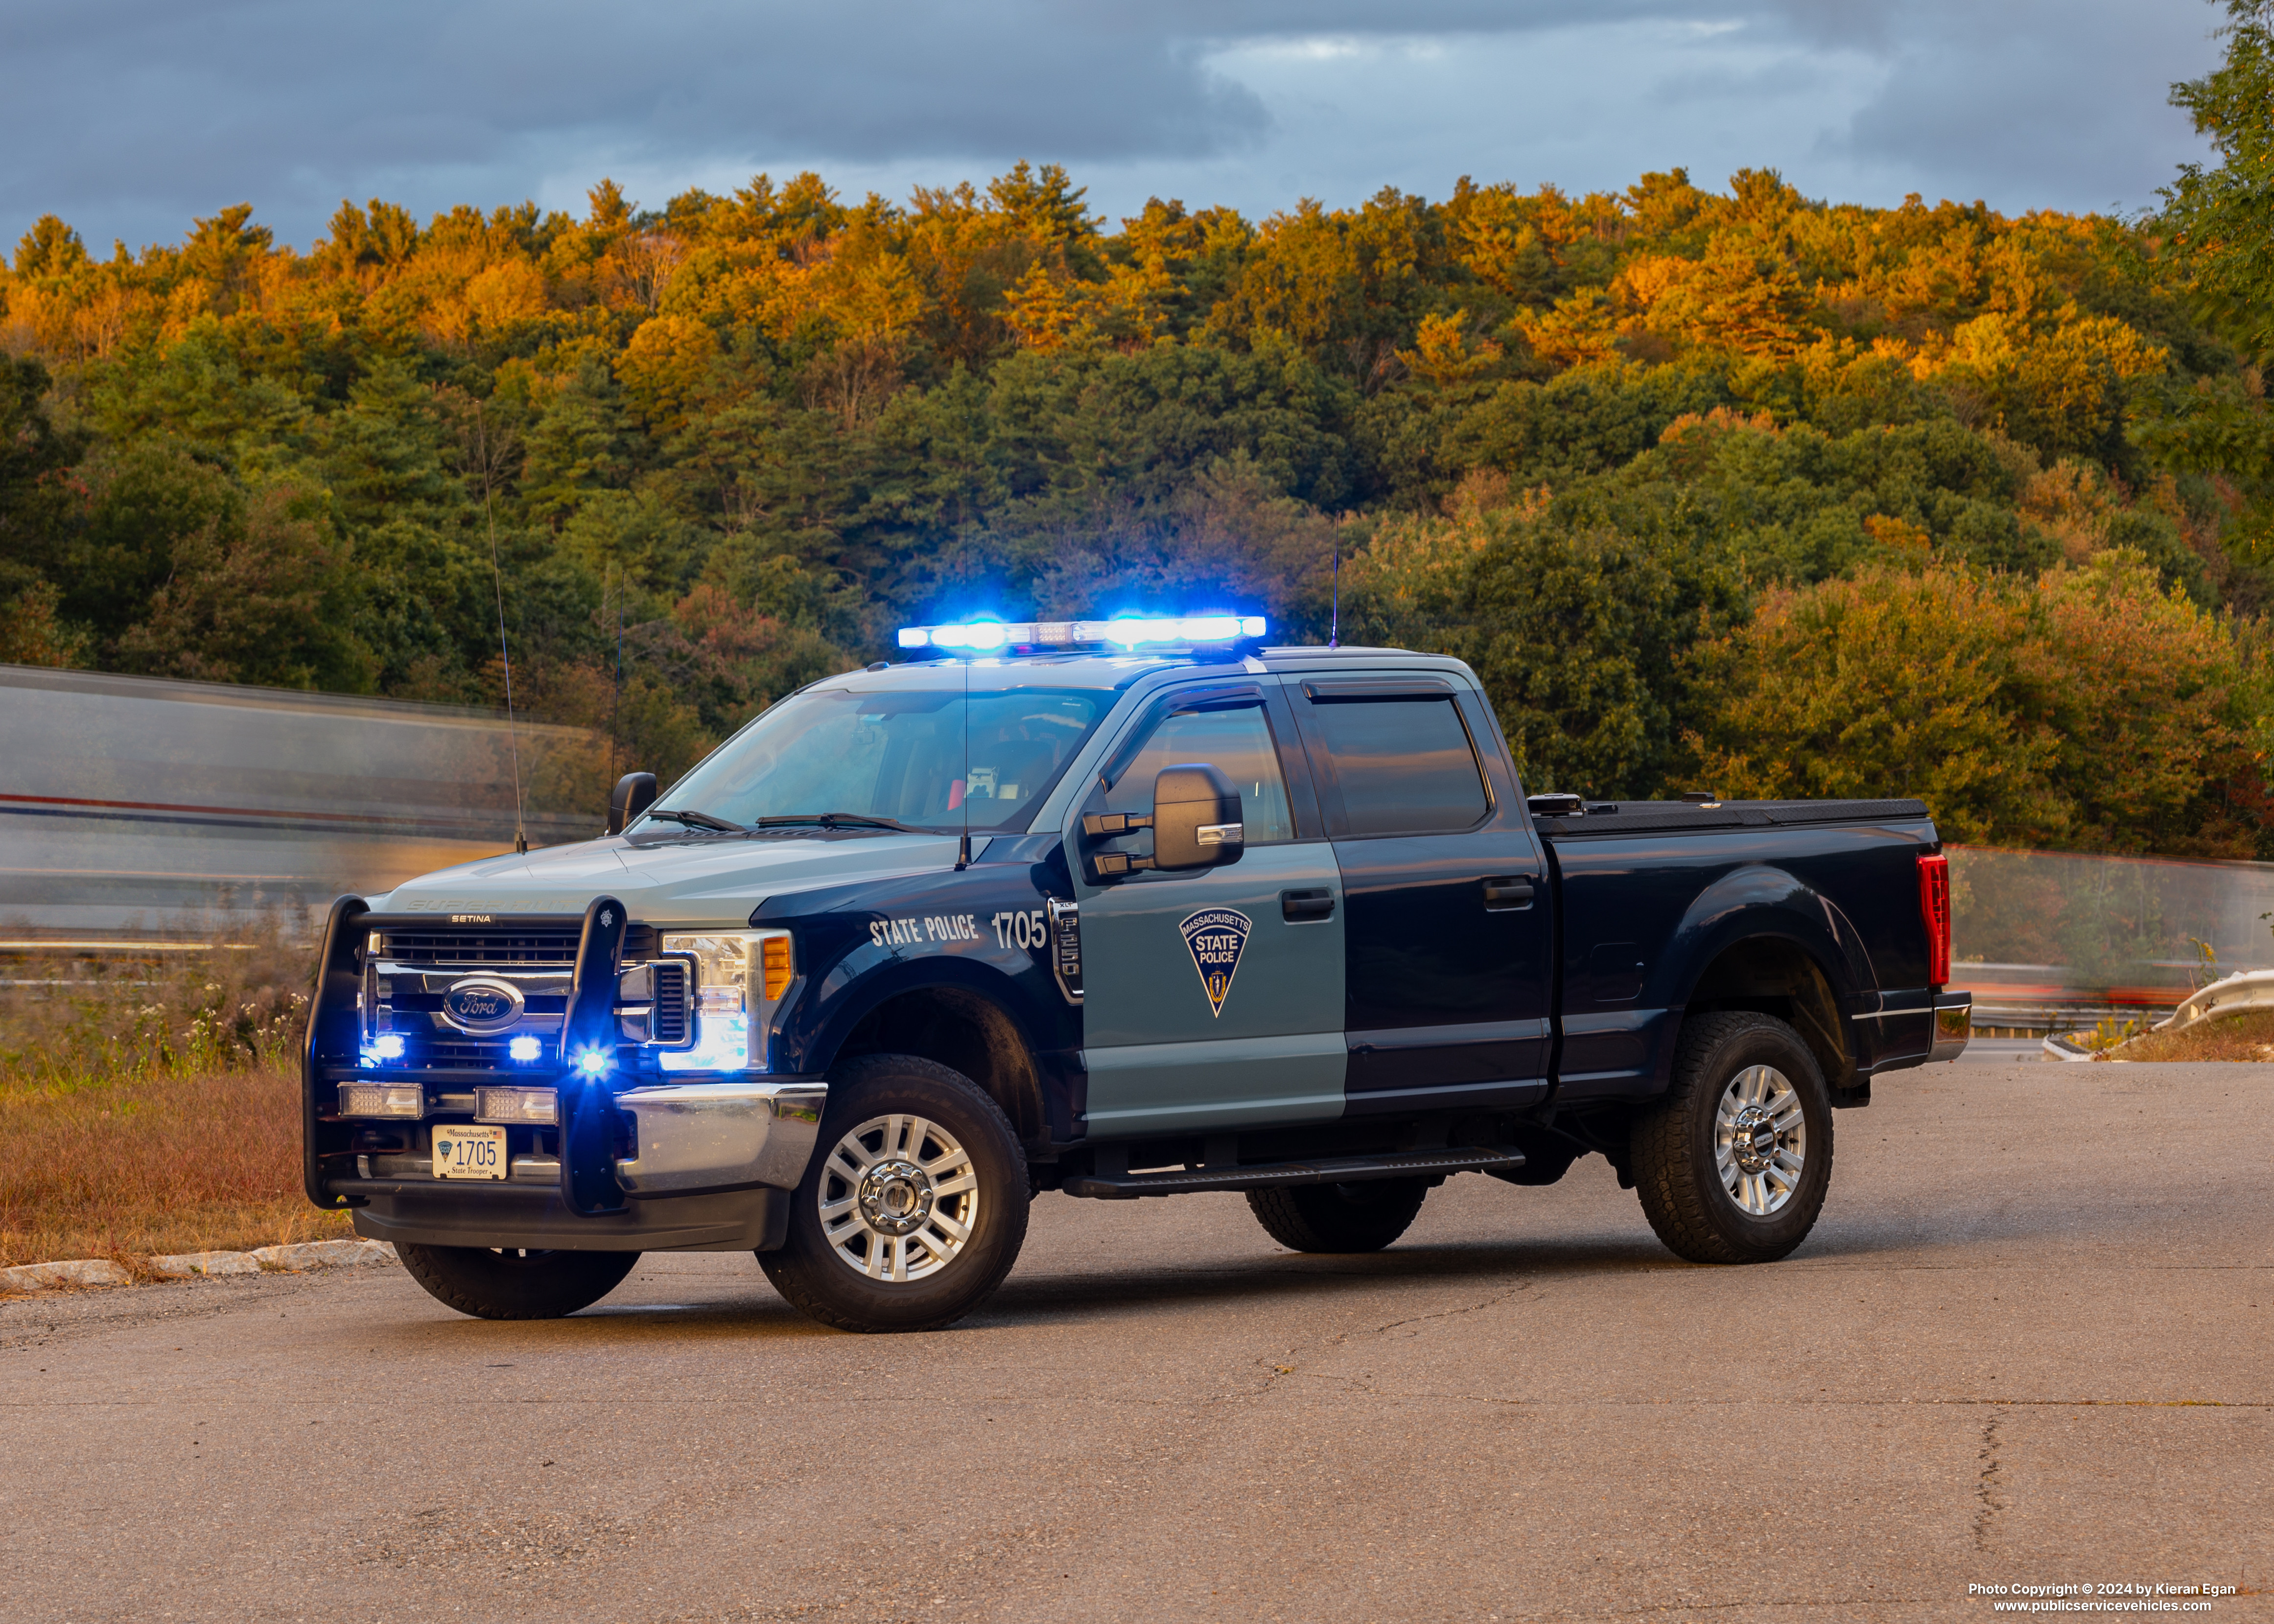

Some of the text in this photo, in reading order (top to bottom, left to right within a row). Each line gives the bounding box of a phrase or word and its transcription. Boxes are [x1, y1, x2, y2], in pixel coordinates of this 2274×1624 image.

[406, 900, 505, 911] SUPER
[869, 910, 1047, 950] STATE POLICE 1705
[1183, 913, 1249, 935] MASSACHUSETTS
[1196, 935, 1238, 951] STATE
[1200, 951, 1234, 964] POLICE
[460, 992, 498, 1015] Ford
[449, 1129, 490, 1138] Massachusetts
[456, 1140, 496, 1165] 1705
[467, 1167, 489, 1176] Trooper
